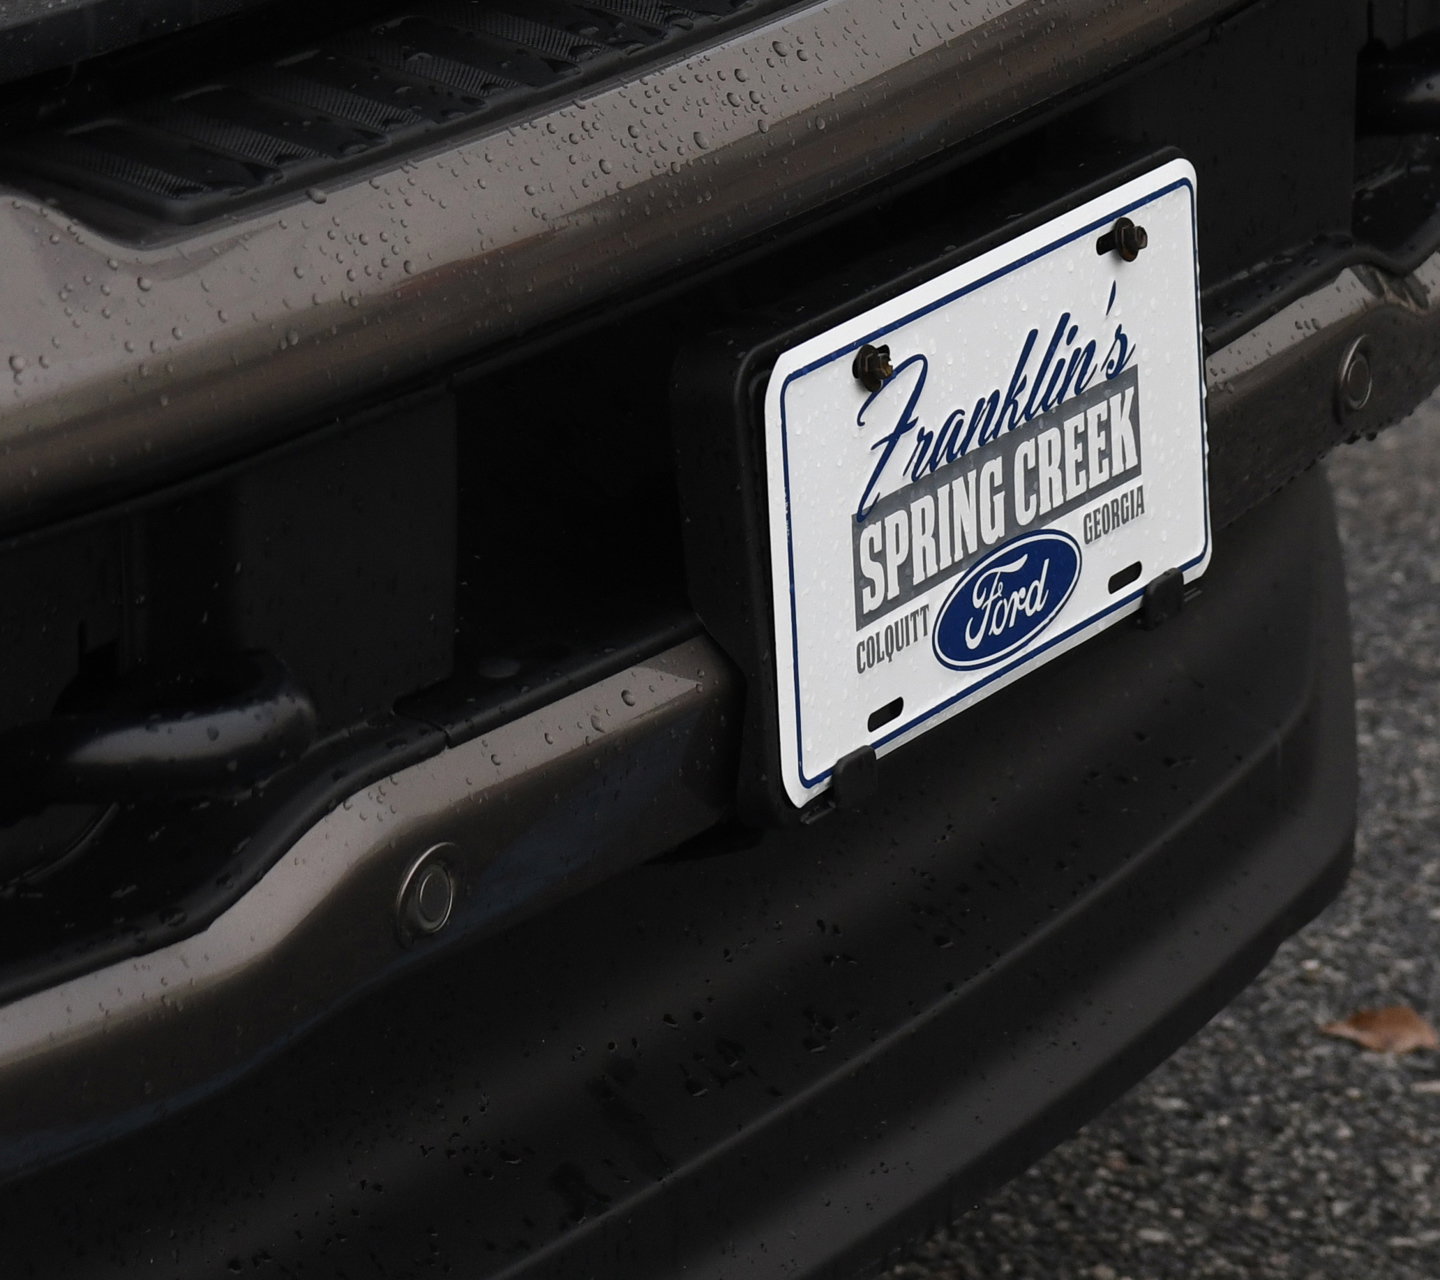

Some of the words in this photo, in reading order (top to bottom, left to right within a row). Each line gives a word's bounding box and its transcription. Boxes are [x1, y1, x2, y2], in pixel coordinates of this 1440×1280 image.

[856, 280, 1136, 521] Franklin's
[859, 456, 1006, 614] SPRING
[1013, 386, 1139, 525] CREEK
[1083, 486, 1145, 545] GEORGIA
[856, 605, 930, 675] COLQUITT
[965, 554, 1049, 650] Ford
